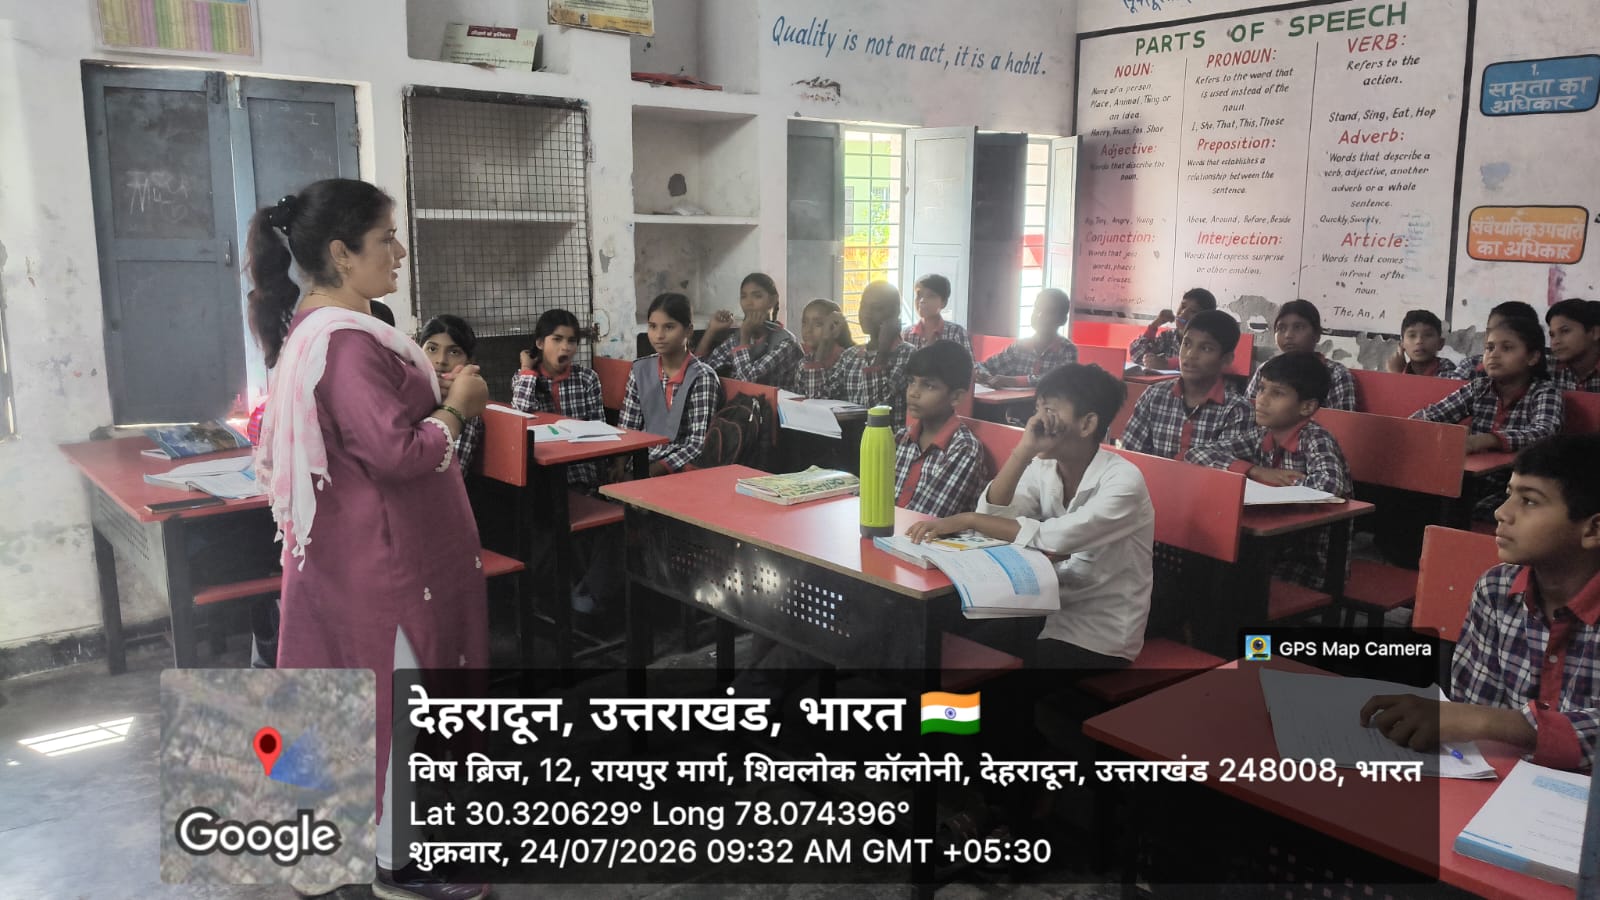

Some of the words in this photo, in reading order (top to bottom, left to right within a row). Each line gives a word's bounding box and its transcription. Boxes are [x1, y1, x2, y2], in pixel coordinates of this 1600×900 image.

[1136, 30, 1206, 56] PARTS
[1231, 22, 1265, 43] OF
[1288, 3, 1407, 37] SPEECH
[772, 16, 837, 58] Quality
[843, 29, 858, 51] is
[865, 35, 893, 57] not
[896, 42, 915, 60] an
[920, 43, 950, 71] act,
[954, 46, 969, 66] it
[971, 48, 985, 68] is
[991, 54, 1001, 71] a
[1005, 51, 1046, 75] habit.
[1347, 33, 1407, 54] VERB:
[1206, 47, 1277, 68] PRONOUN:
[1346, 59, 1383, 72] Refers
[1386, 58, 1398, 67] to
[1401, 54, 1421, 66] the
[1115, 62, 1154, 78] NOUN:
[1195, 75, 1220, 85] Refers
[1223, 74, 1232, 83] to
[1233, 73, 1248, 81] the
[1250, 69, 1273, 80] word
[1275, 67, 1294, 77] that
[1530, 63, 1540, 77] 1.
[1363, 74, 1403, 86] action.
[1488, 78, 1555, 97] समता
[1558, 76, 1593, 95] का
[1200, 90, 1208, 99] is
[1209, 88, 1230, 97] used
[1230, 85, 1262, 97] instead
[1264, 84, 1274, 94] of
[1275, 83, 1290, 93] the
[1490, 94, 1578, 114] अधिकार
[1328, 111, 1360, 123] Stand,
[1363, 109, 1389, 121] Sing,
[1392, 107, 1413, 119] Eat,
[1415, 106, 1437, 119] Hop
[1216, 119, 1238, 130] That,
[1240, 117, 1258, 128] This,
[1259, 116, 1285, 127] Those
[1338, 127, 1405, 145] Adverb:
[1100, 142, 1158, 159] Adjective:
[1197, 136, 1276, 154] Preposition:
[1206, 158, 1220, 166] that
[1260, 157, 1266, 165] a
[1329, 151, 1357, 162] Words
[1359, 151, 1380, 162] that
[1383, 149, 1422, 162] describe
[1187, 173, 1227, 181] relationship
[1261, 169, 1275, 179] the
[1345, 167, 1388, 178] adjective,
[1390, 166, 1430, 175] another
[1331, 184, 1362, 192] adverb
[1388, 182, 1417, 191] whole
[1350, 199, 1393, 208] sentence.
[1270, 215, 1292, 223] Beside
[1086, 231, 1156, 246] Conjunction:
[1197, 231, 1283, 247] Interjection:
[1340, 232, 1409, 248] Article:
[1184, 251, 1205, 260] Words
[1206, 251, 1223, 260] that
[1223, 254, 1249, 262] express
[1476, 240, 1503, 256] का
[1503, 238, 1575, 259] अधिकार
[1321, 253, 1349, 263] Words
[1354, 254, 1375, 263] that
[1377, 257, 1404, 265] comes
[1379, 271, 1392, 280] of
[1391, 270, 1405, 280] the
[1333, 306, 1354, 318] The,
[1378, 309, 1386, 319] A
